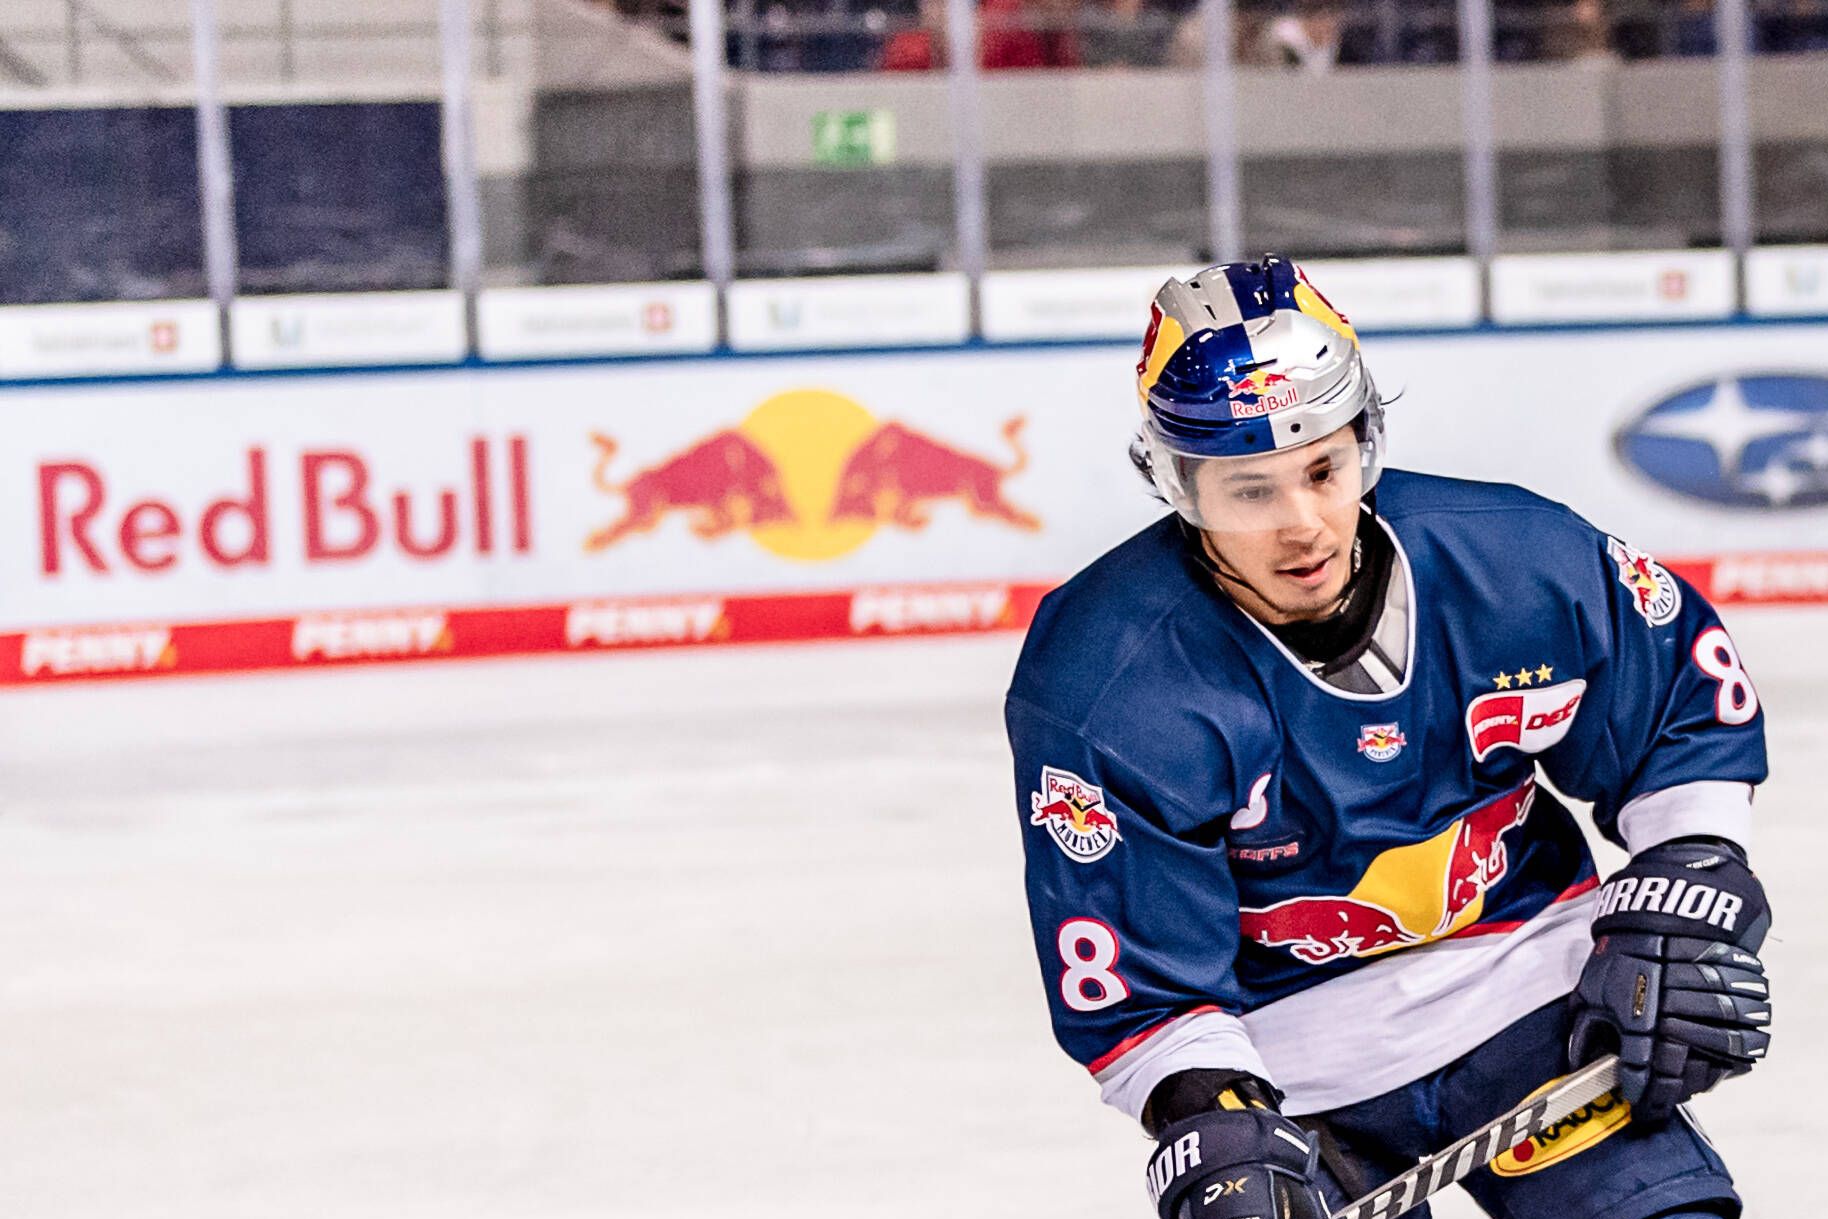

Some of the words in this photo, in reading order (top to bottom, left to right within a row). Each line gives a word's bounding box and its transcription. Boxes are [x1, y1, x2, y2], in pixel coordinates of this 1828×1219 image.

[1232, 398, 1266, 418] Red
[1267, 389, 1298, 413] Bull
[36, 446, 271, 578] Red
[301, 435, 533, 564] Bull
[1691, 625, 1760, 726] 8
[1049, 778, 1074, 797] Red
[1056, 916, 1131, 1012] 8
